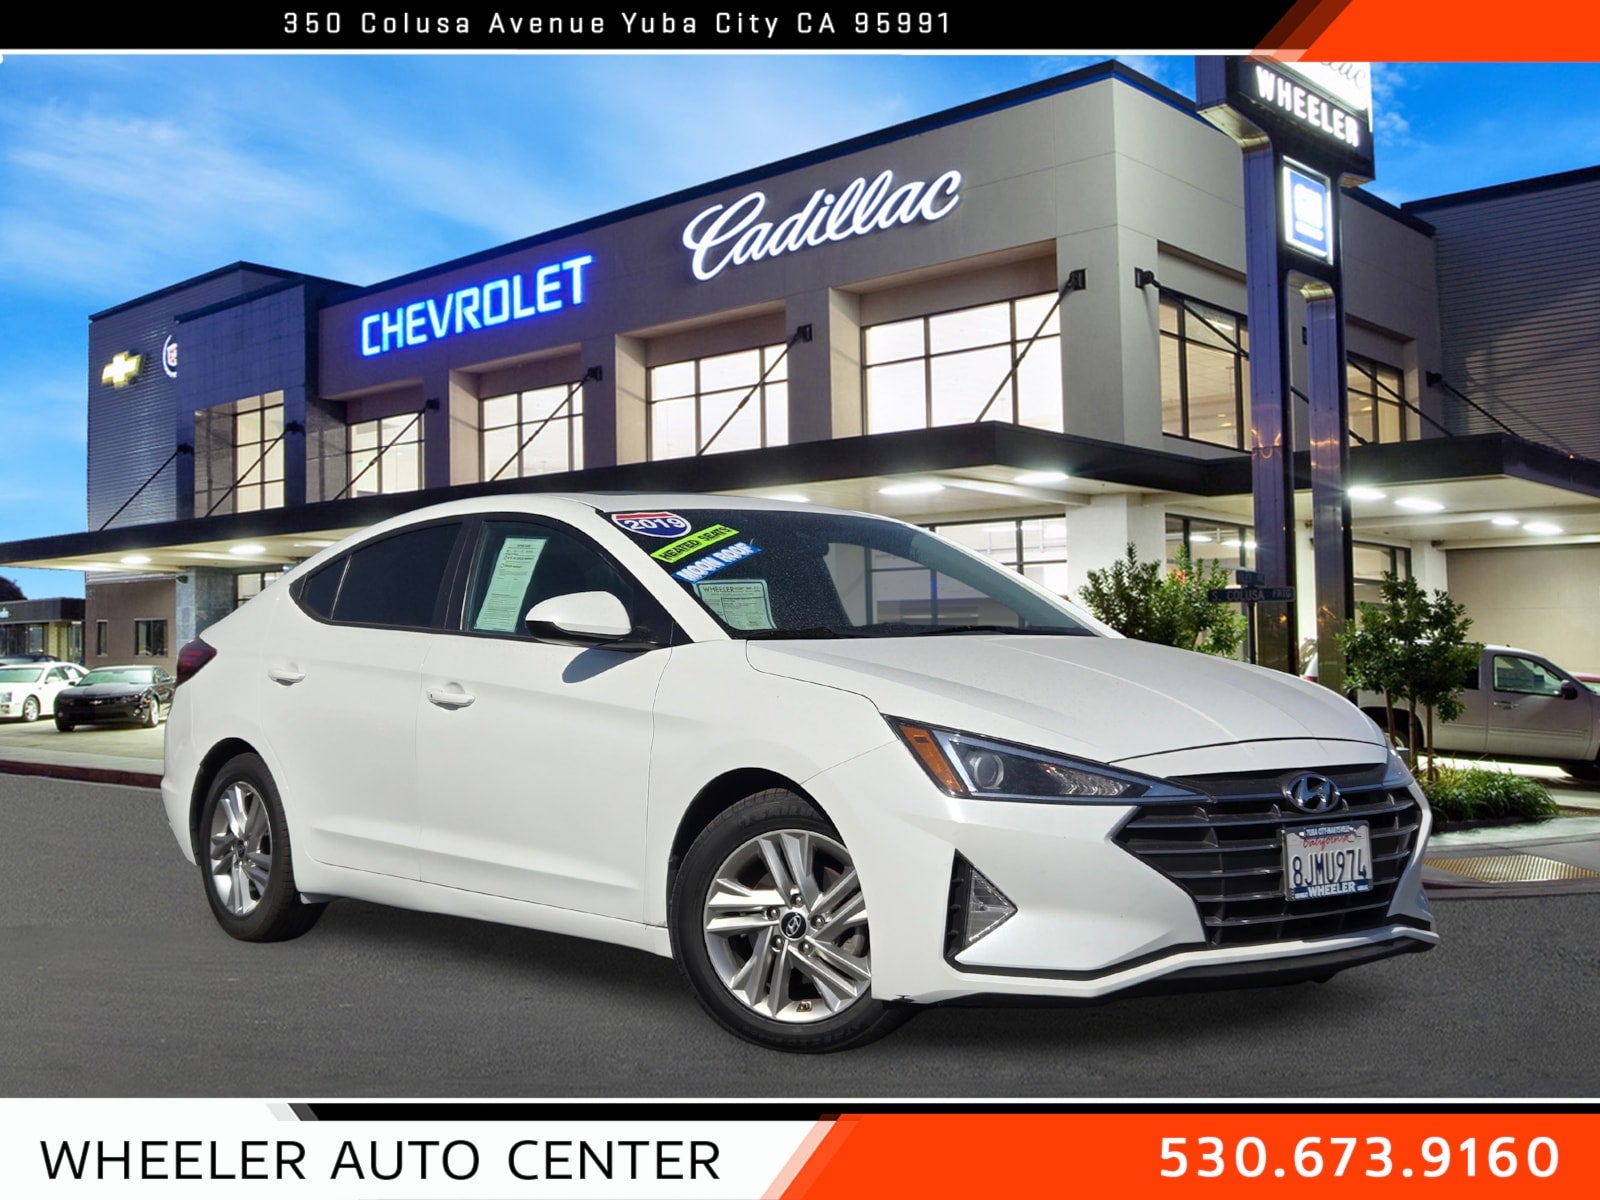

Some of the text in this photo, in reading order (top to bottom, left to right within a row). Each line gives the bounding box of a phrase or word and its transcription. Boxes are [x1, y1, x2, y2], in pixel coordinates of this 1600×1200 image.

[1254, 65, 1361, 147] WHEELER
[682, 169, 963, 281] Cadillac
[360, 254, 594, 357] CHEVROLET
[624, 517, 687, 531] 2019
[661, 527, 733, 558] HEATED SEATS
[677, 542, 753, 581] MOON ROOF
[1226, 589, 1265, 602] COLUSA
[1292, 848, 1367, 887] 8JMU974
[1307, 881, 1356, 898] WHEELER
